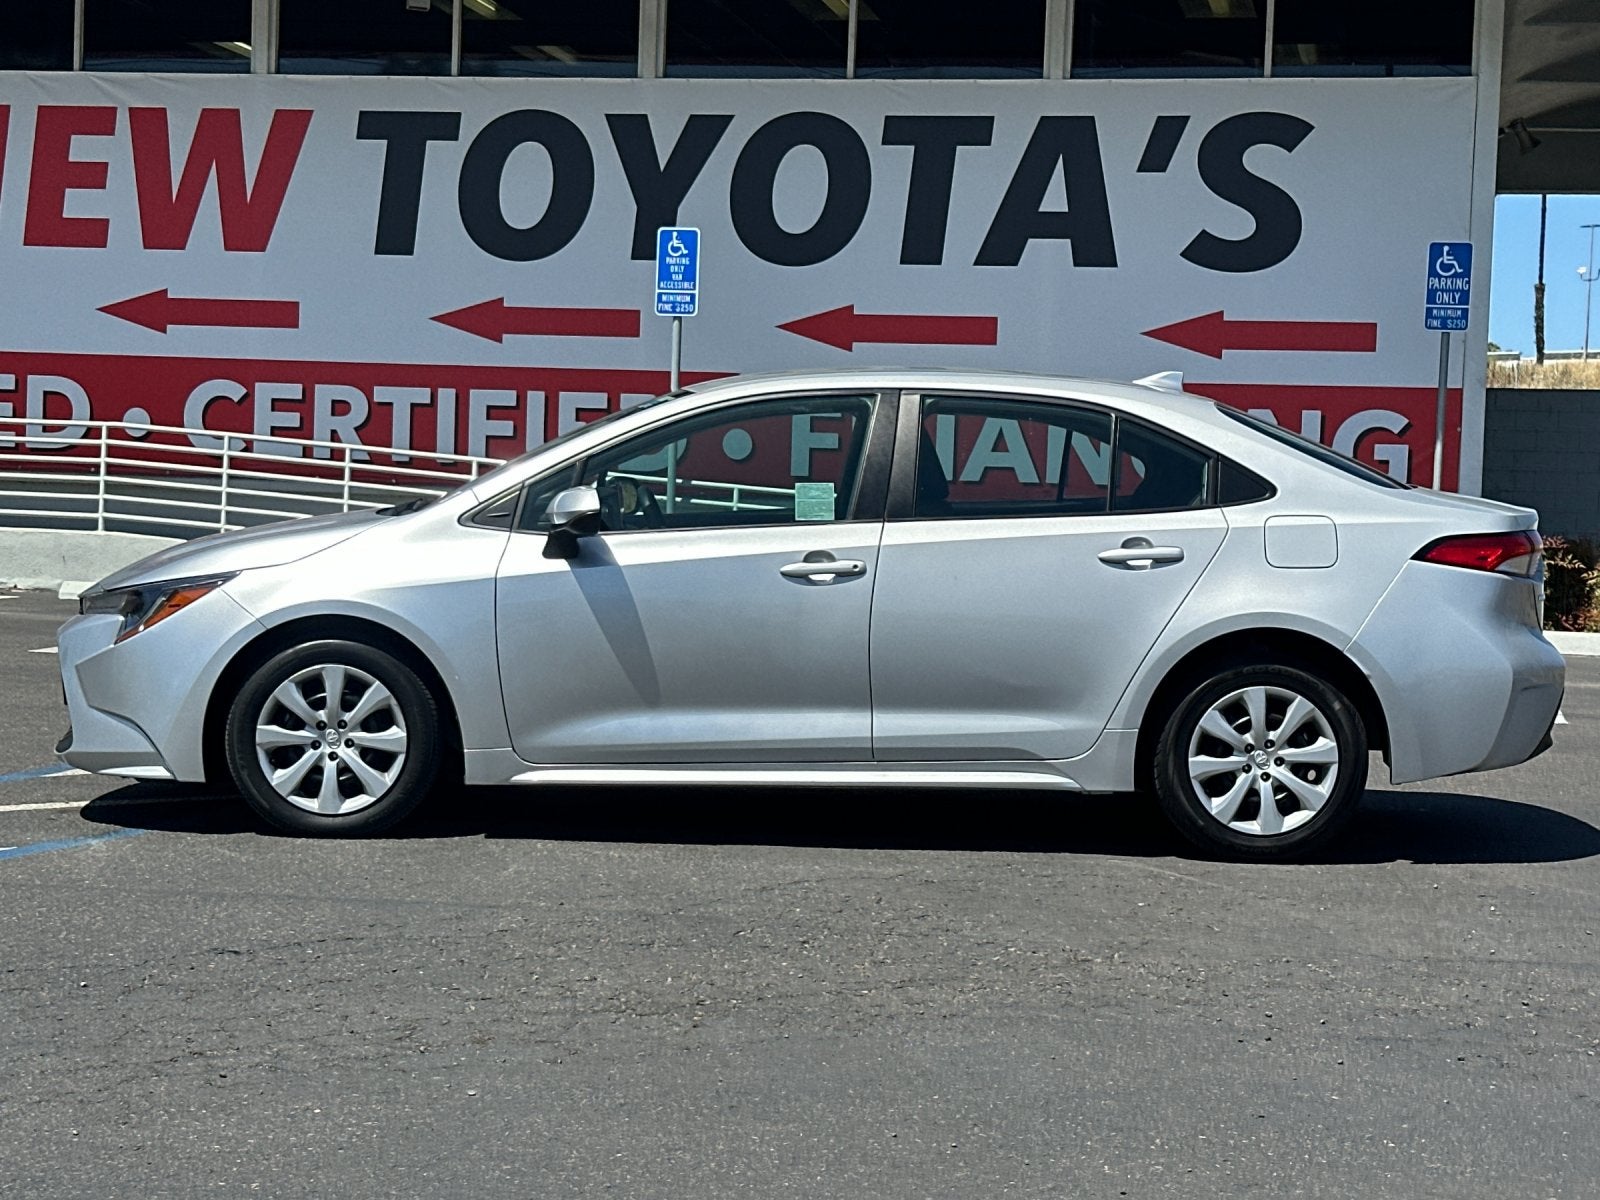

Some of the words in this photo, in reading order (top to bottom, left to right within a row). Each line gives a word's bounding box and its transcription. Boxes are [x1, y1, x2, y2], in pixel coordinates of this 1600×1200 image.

[0, 104, 314, 252] EW
[356, 109, 1313, 272] TOYOTA'S
[665, 257, 690, 265] PARKING
[670, 265, 685, 273] ONLY
[660, 281, 695, 289] ACCESSIBLE
[1428, 277, 1469, 290] PARKING
[661, 294, 691, 303] MINIMUM
[1436, 291, 1461, 304] ONLY
[658, 303, 673, 312] FINE
[1432, 308, 1462, 317] MINIMUM
[1427, 318, 1442, 328] FINE
[1446, 319, 1466, 328] $250
